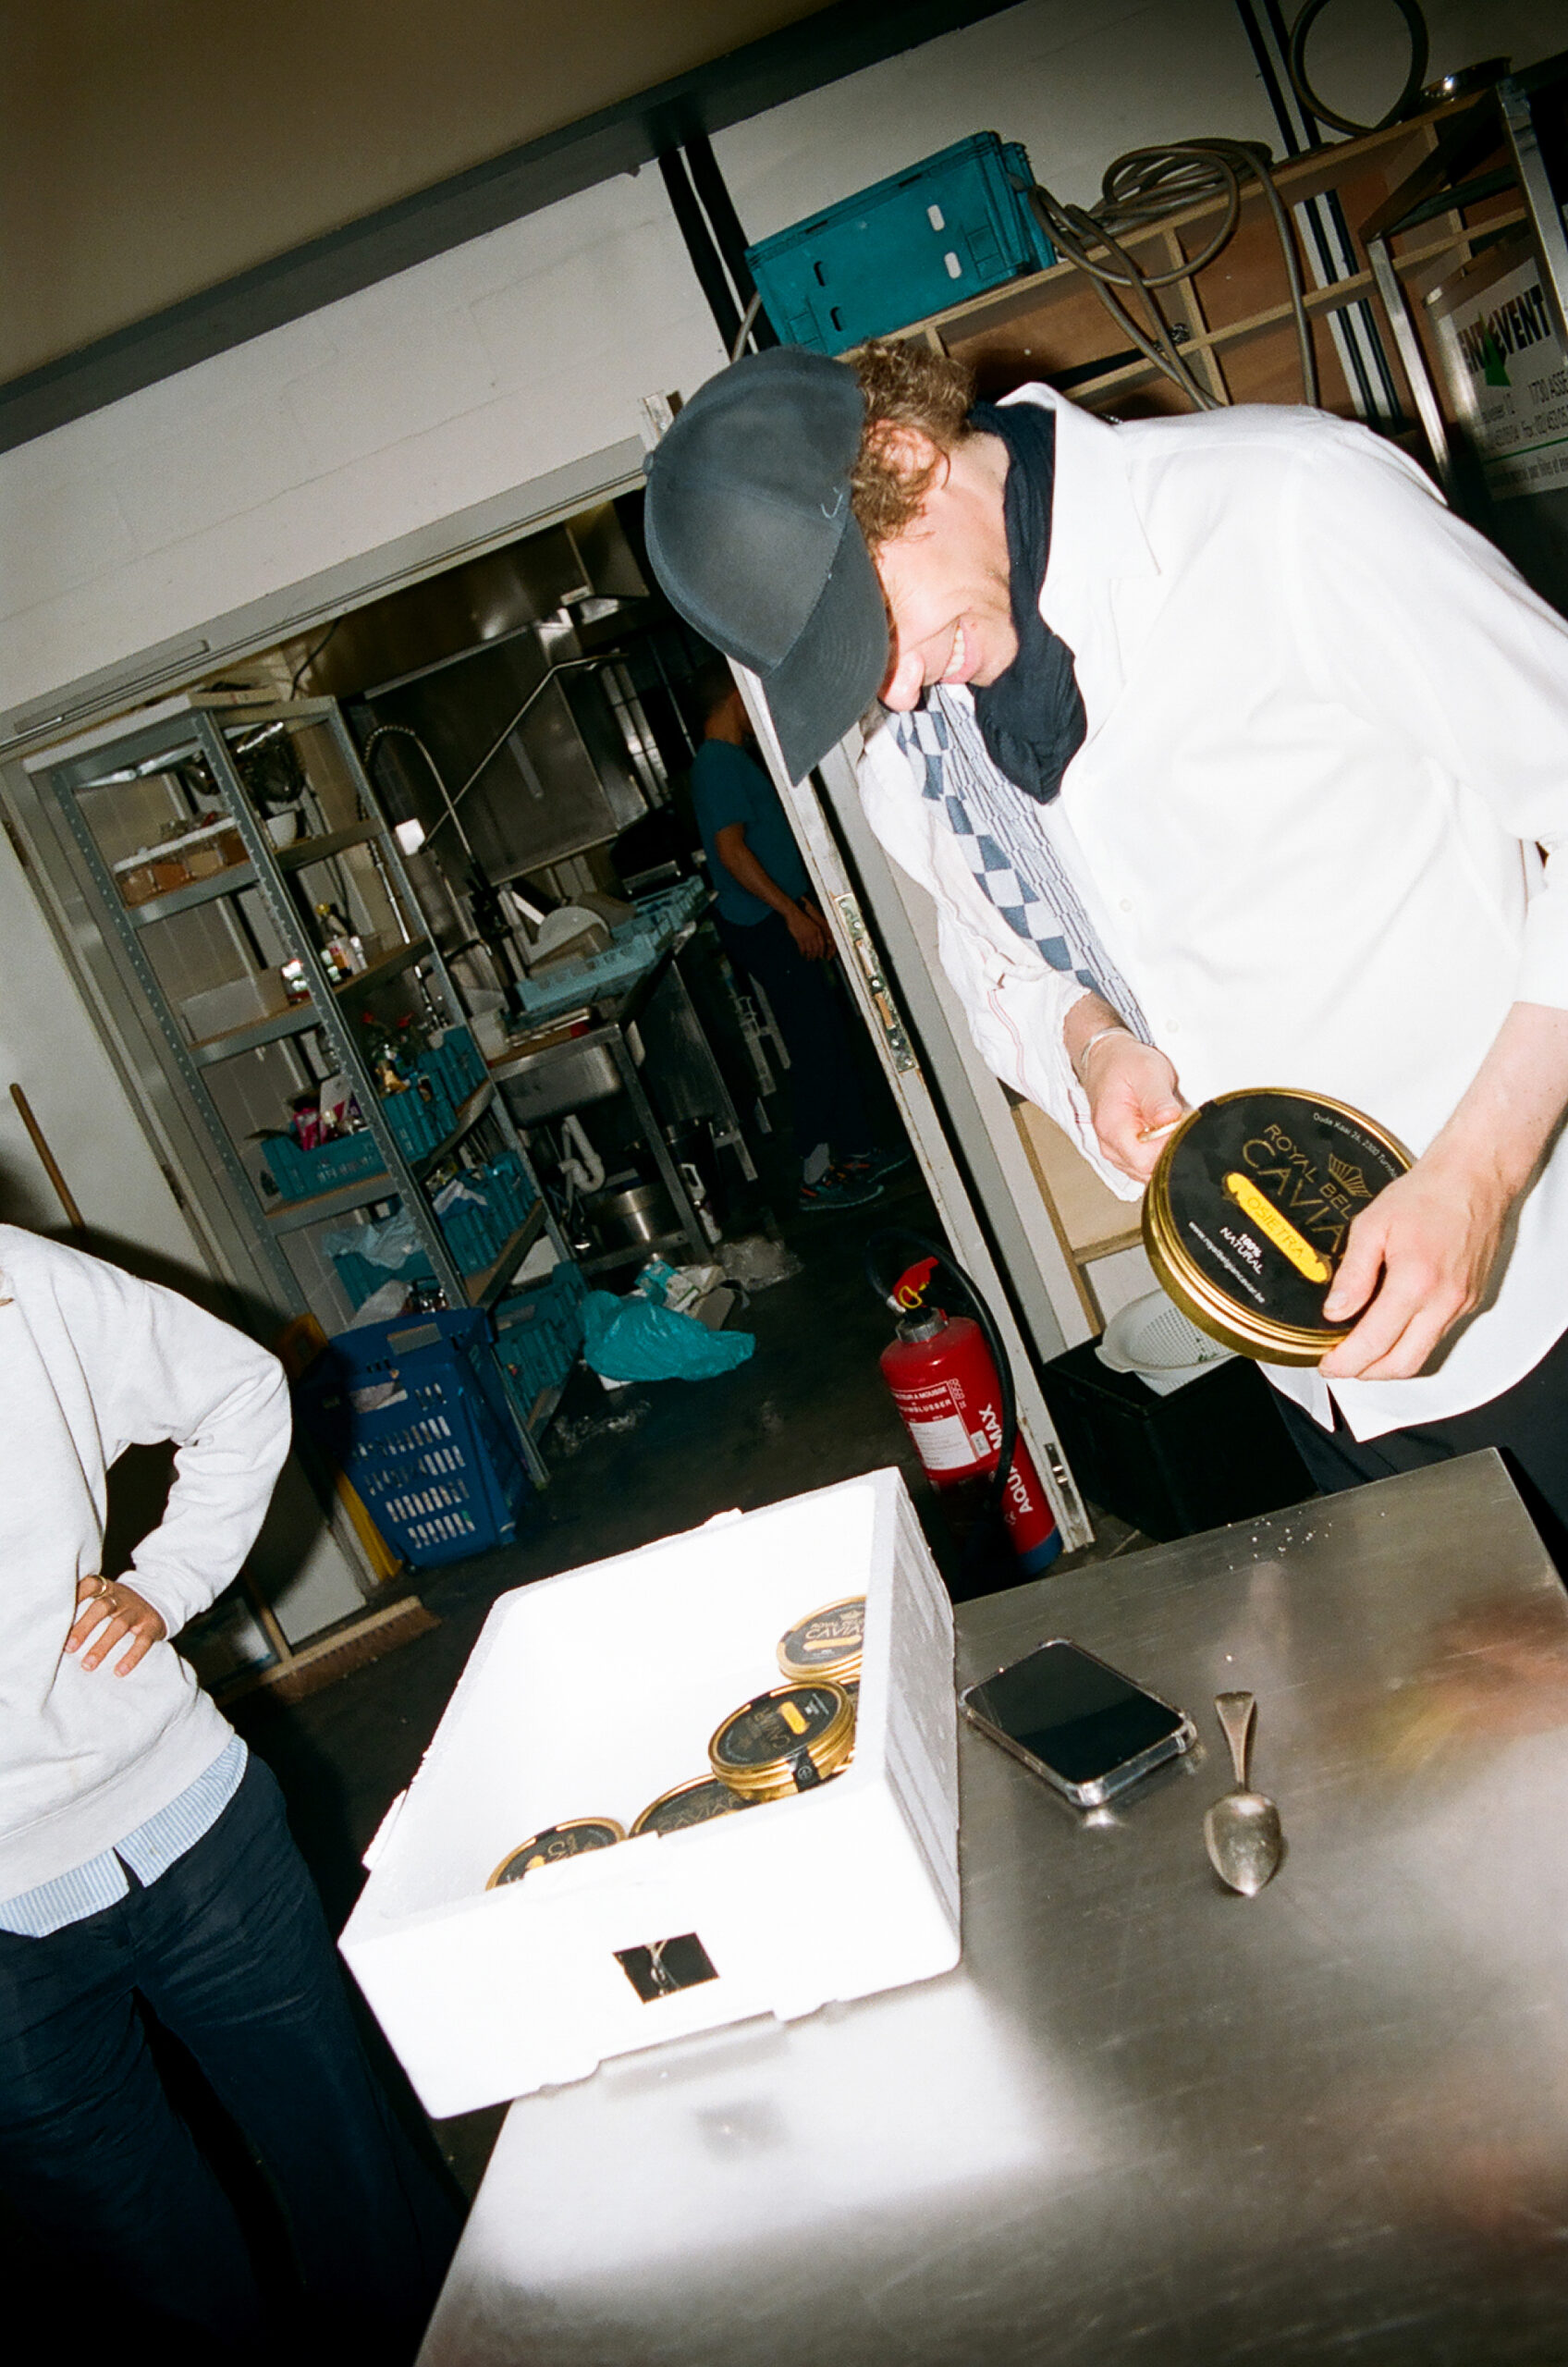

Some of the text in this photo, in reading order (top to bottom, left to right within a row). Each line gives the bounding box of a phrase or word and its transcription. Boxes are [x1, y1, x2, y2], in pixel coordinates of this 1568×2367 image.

[1263, 1123, 1353, 1220] ROYAL BEL
[1243, 1138, 1346, 1258] CAVIA
[1219, 1226, 1264, 1275] NATURAL
[1239, 1233, 1263, 1258] 100%
[1247, 1196, 1305, 1259] OSIETRA
[918, 1386, 948, 1399] MOUSSE
[978, 1404, 1003, 1450] MAX
